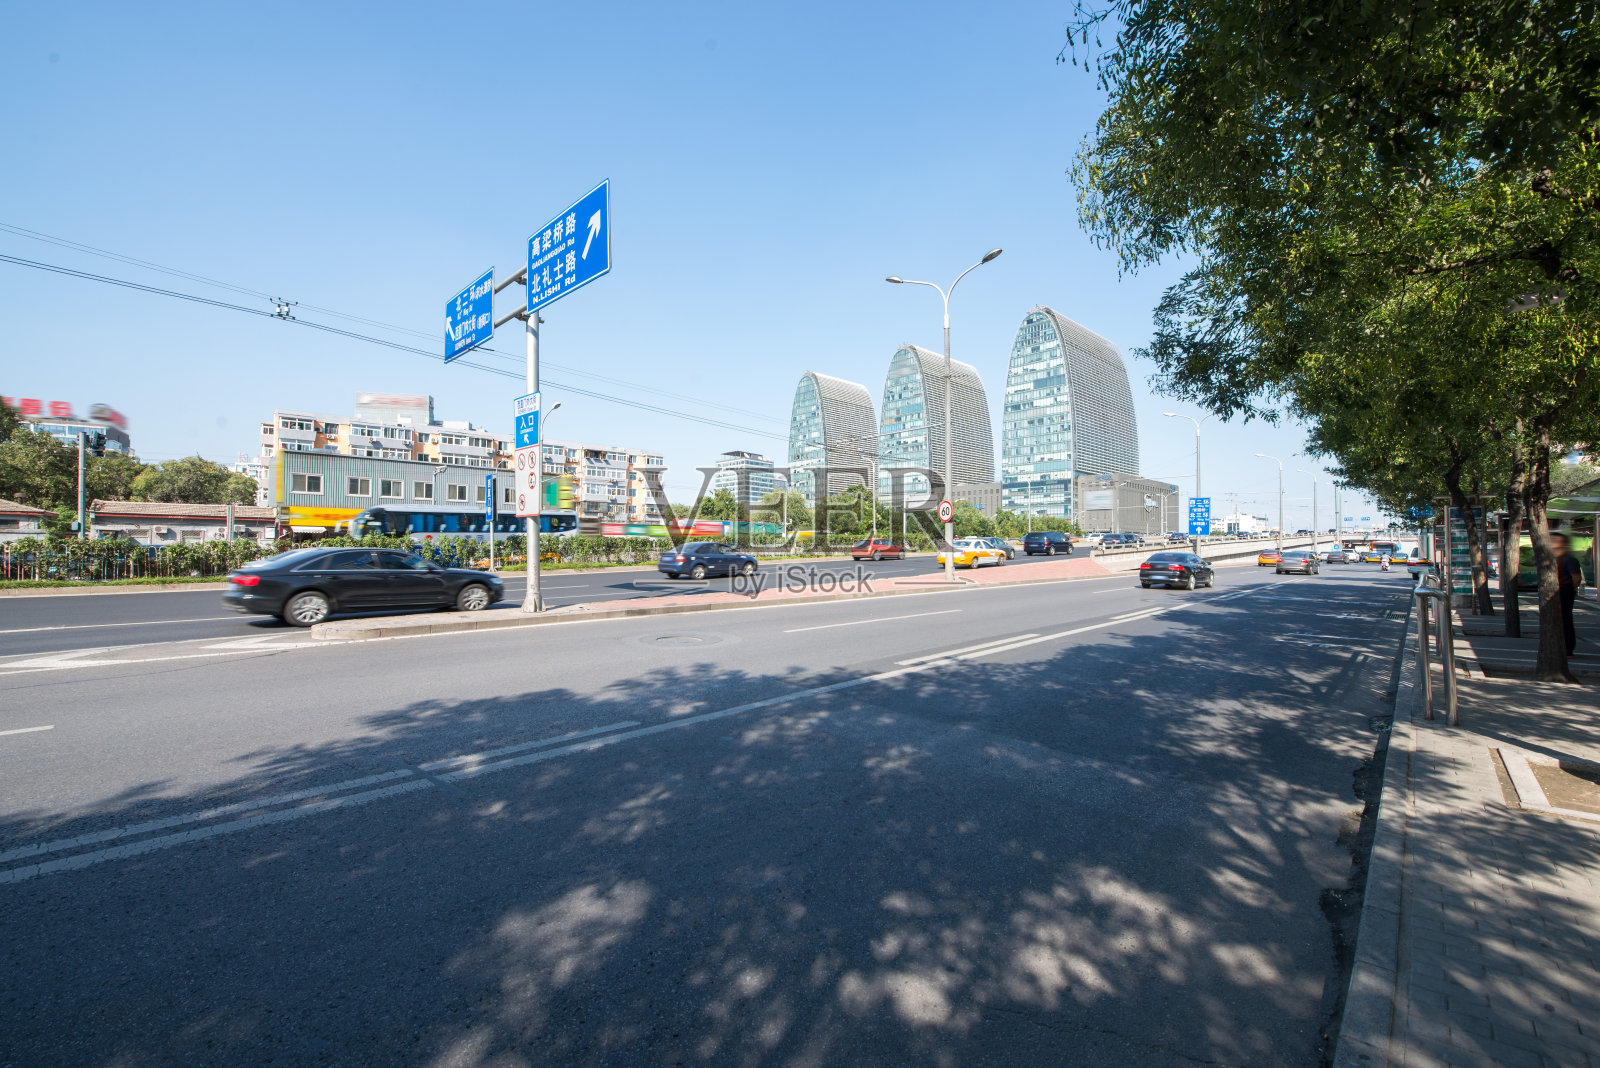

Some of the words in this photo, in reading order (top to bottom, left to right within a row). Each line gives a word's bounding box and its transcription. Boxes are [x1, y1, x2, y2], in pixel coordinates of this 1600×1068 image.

[532, 212, 576, 260] 高梁桥路
[568, 236, 575, 247] Rd
[532, 250, 576, 294] 北礼士路
[532, 282, 560, 304] N.LISHI
[564, 274, 576, 287] Rd
[520, 415, 534, 429] 入口
[942, 506, 950, 516] 60
